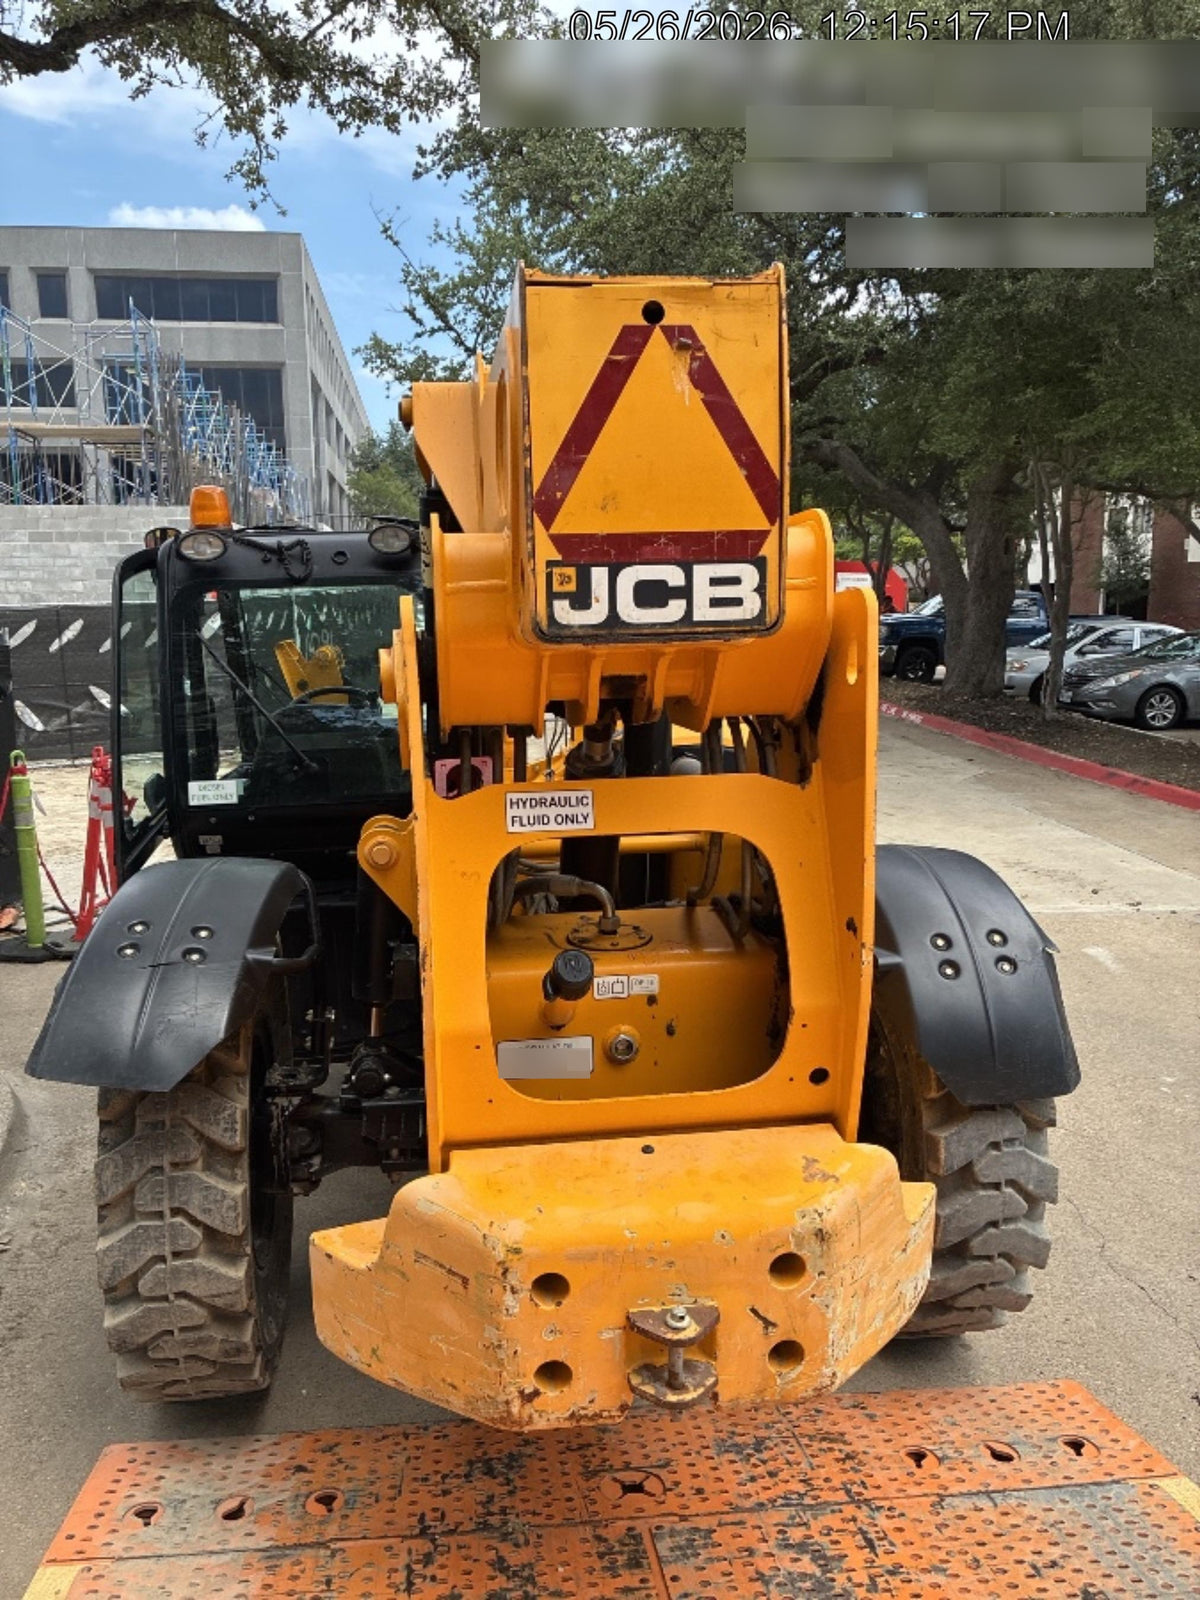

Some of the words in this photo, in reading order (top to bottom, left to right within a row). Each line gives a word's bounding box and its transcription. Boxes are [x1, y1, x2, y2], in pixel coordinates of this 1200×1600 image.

[552, 563, 762, 625] JCB
[509, 795, 590, 809] HYDRAULIC
[511, 814, 550, 827] FLUID
[554, 812, 590, 826] ONLY
